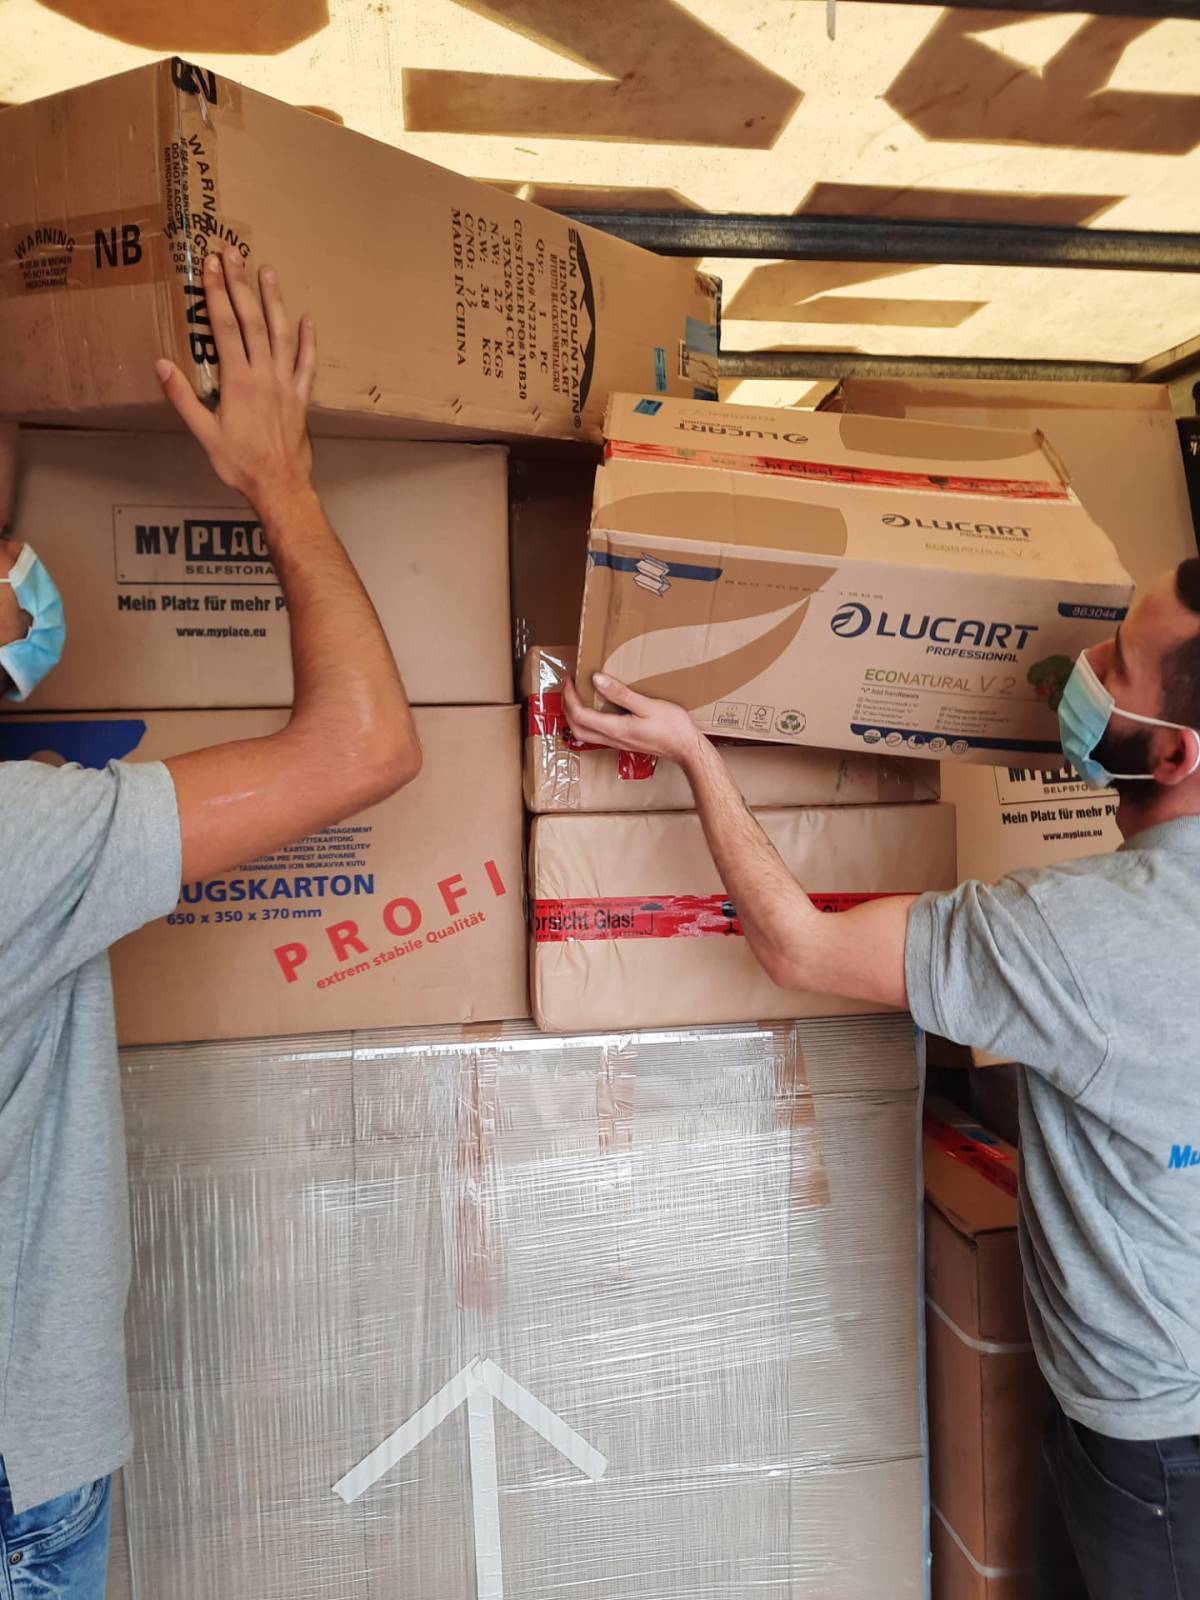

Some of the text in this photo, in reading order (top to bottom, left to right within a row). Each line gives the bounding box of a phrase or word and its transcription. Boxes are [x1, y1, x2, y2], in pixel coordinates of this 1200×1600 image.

[172, 143, 179, 159] DO
[173, 162, 181, 184] NOT
[15, 228, 76, 259] WARNING
[95, 224, 142, 269] NB
[464, 213, 475, 269] C/NO:
[568, 228, 578, 278] SUN
[536, 239, 546, 275] Qty:
[451, 208, 467, 365] MADE IN CHINA
[477, 218, 492, 376] G.W: 3.8 KGS
[490, 222, 504, 379] N.W: 2.7 KGS
[502, 235, 515, 356] 37X26X94 CM
[513, 219, 527, 400] CUSTOMER PO# MB20
[527, 262, 537, 360] PO# N22216
[559, 259, 570, 396] H2NO LITE CART
[540, 351, 549, 373] PC
[674, 422, 778, 440] LUCART
[135, 524, 270, 557] MY PLAC
[915, 517, 1032, 538] LUCART
[185, 564, 275, 576] SELFSTORA
[117, 594, 156, 612] Mein
[161, 595, 200, 612] Platz
[204, 594, 227, 612] für
[231, 596, 271, 612] mehr
[1071, 606, 1118, 620] 863044
[176, 626, 267, 638] www.myplace.eu
[876, 611, 1039, 651] LUCART
[926, 645, 1019, 663] PROFESSIONAL
[864, 668, 1018, 695] ECONATURAL V 2
[1043, 784, 1089, 794] SELFSTO
[1001, 811, 1028, 825] Mein
[1031, 810, 1057, 823] Platz
[1058, 808, 1073, 820] für
[1076, 805, 1103, 818] mehr
[1042, 829, 1103, 841] www.myplace.eu
[177, 873, 375, 904] UGSKARTON
[167, 907, 322, 925] 650 x 350 x 370 mm
[594, 908, 635, 929] Glas!
[316, 910, 487, 990] extrem stabile Qualität
